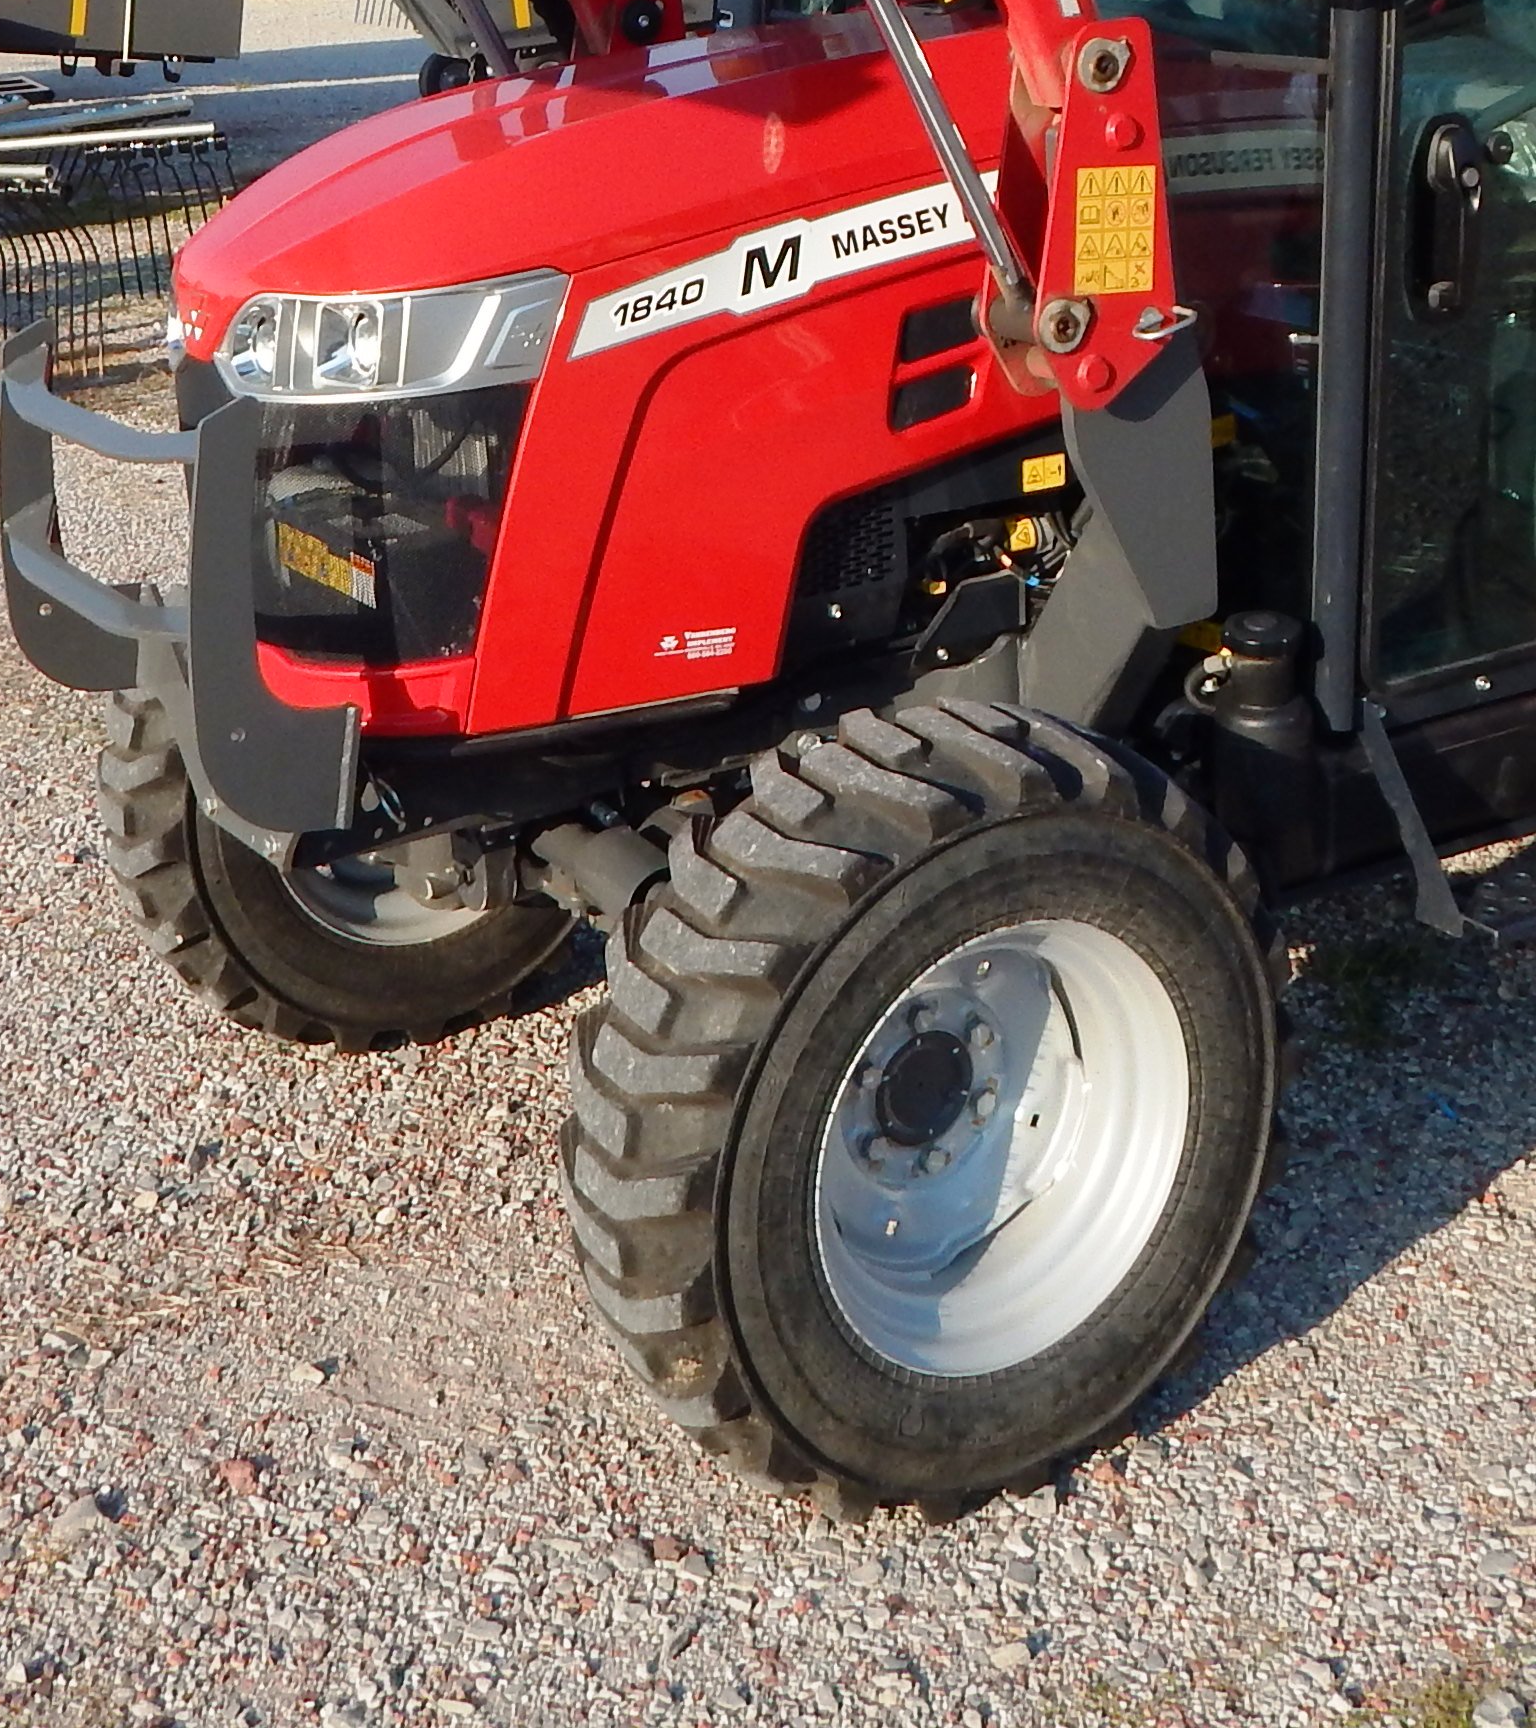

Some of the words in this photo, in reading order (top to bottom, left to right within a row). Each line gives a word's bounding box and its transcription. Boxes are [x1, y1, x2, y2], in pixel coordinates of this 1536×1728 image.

[613, 278, 704, 327] 1840
[740, 234, 803, 296] M
[831, 203, 951, 259] MASSEY
